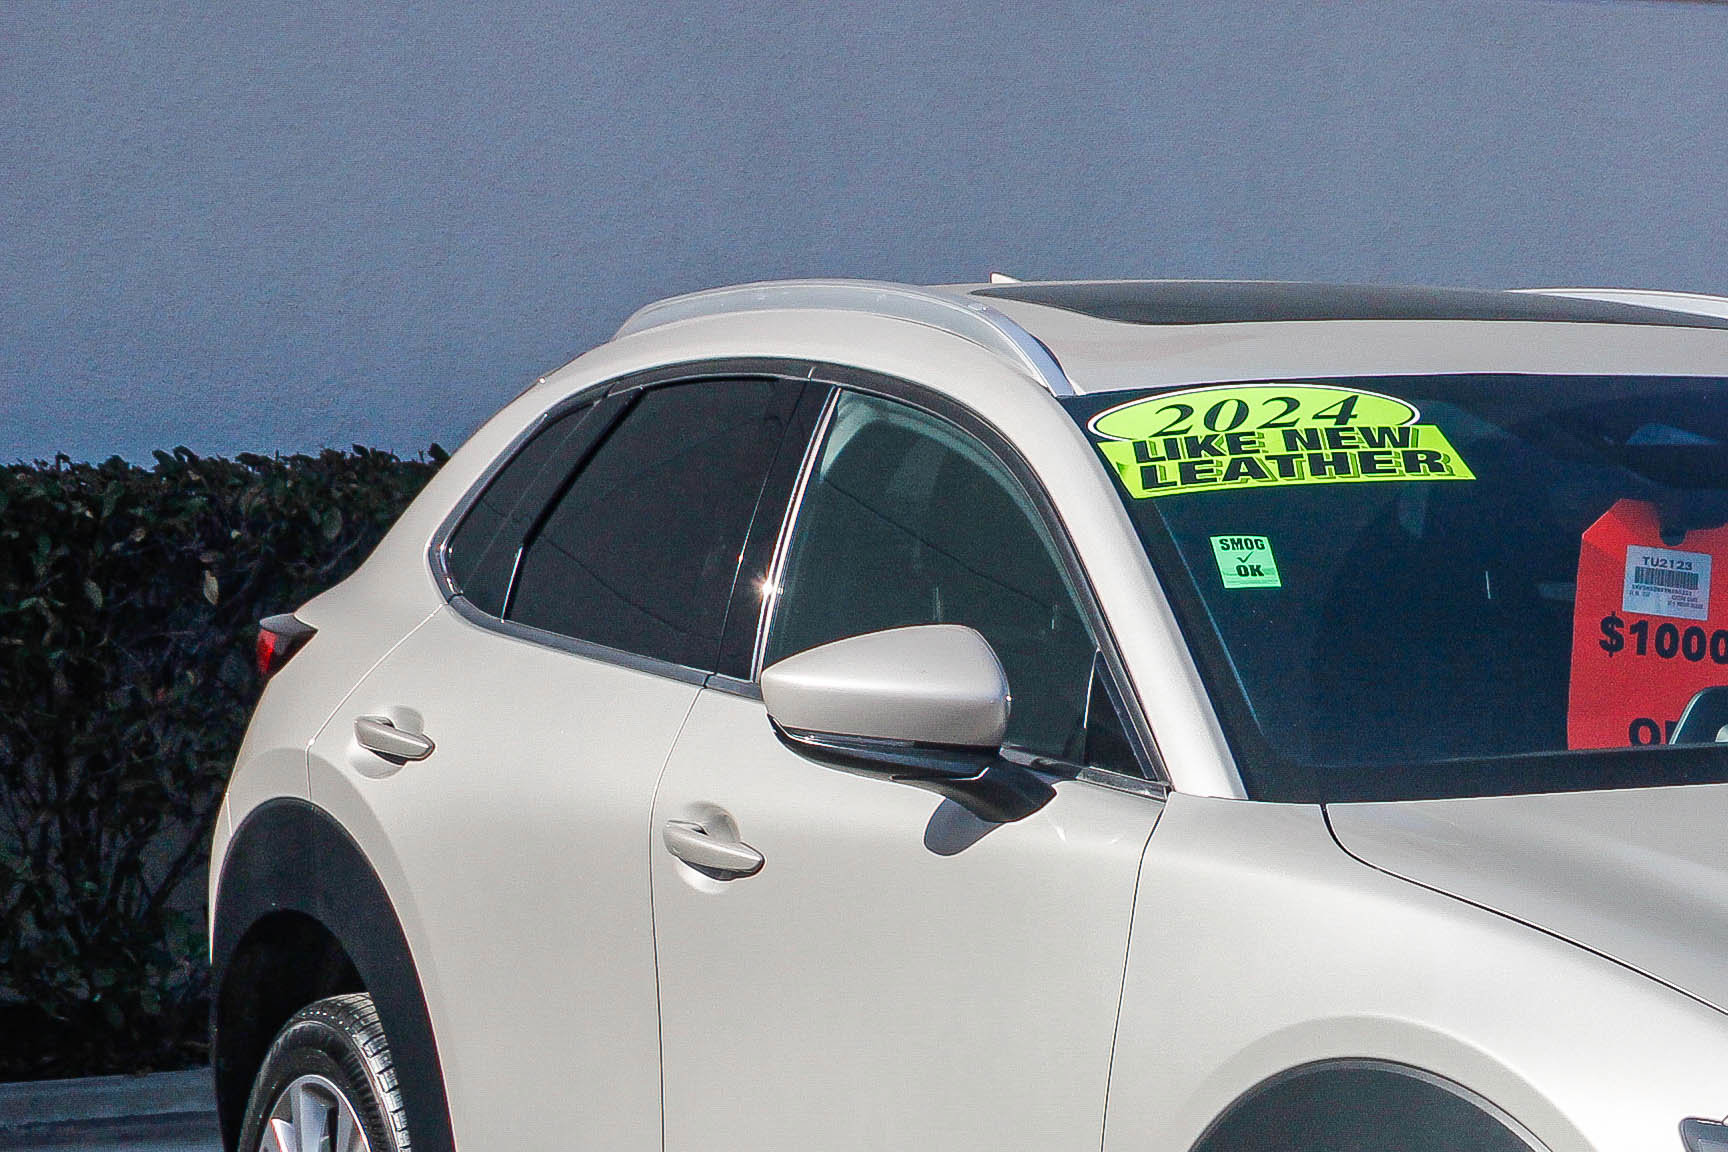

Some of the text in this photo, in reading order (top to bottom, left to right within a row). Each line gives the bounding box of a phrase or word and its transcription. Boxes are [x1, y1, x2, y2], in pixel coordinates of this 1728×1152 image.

[1149, 394, 1359, 437] 2024
[1132, 426, 1415, 463] LIKE NEW
[1140, 449, 1447, 490] LEATHER
[1219, 538, 1266, 552] SMOG
[1236, 564, 1265, 578] OK
[1642, 555, 1693, 571] TU2123
